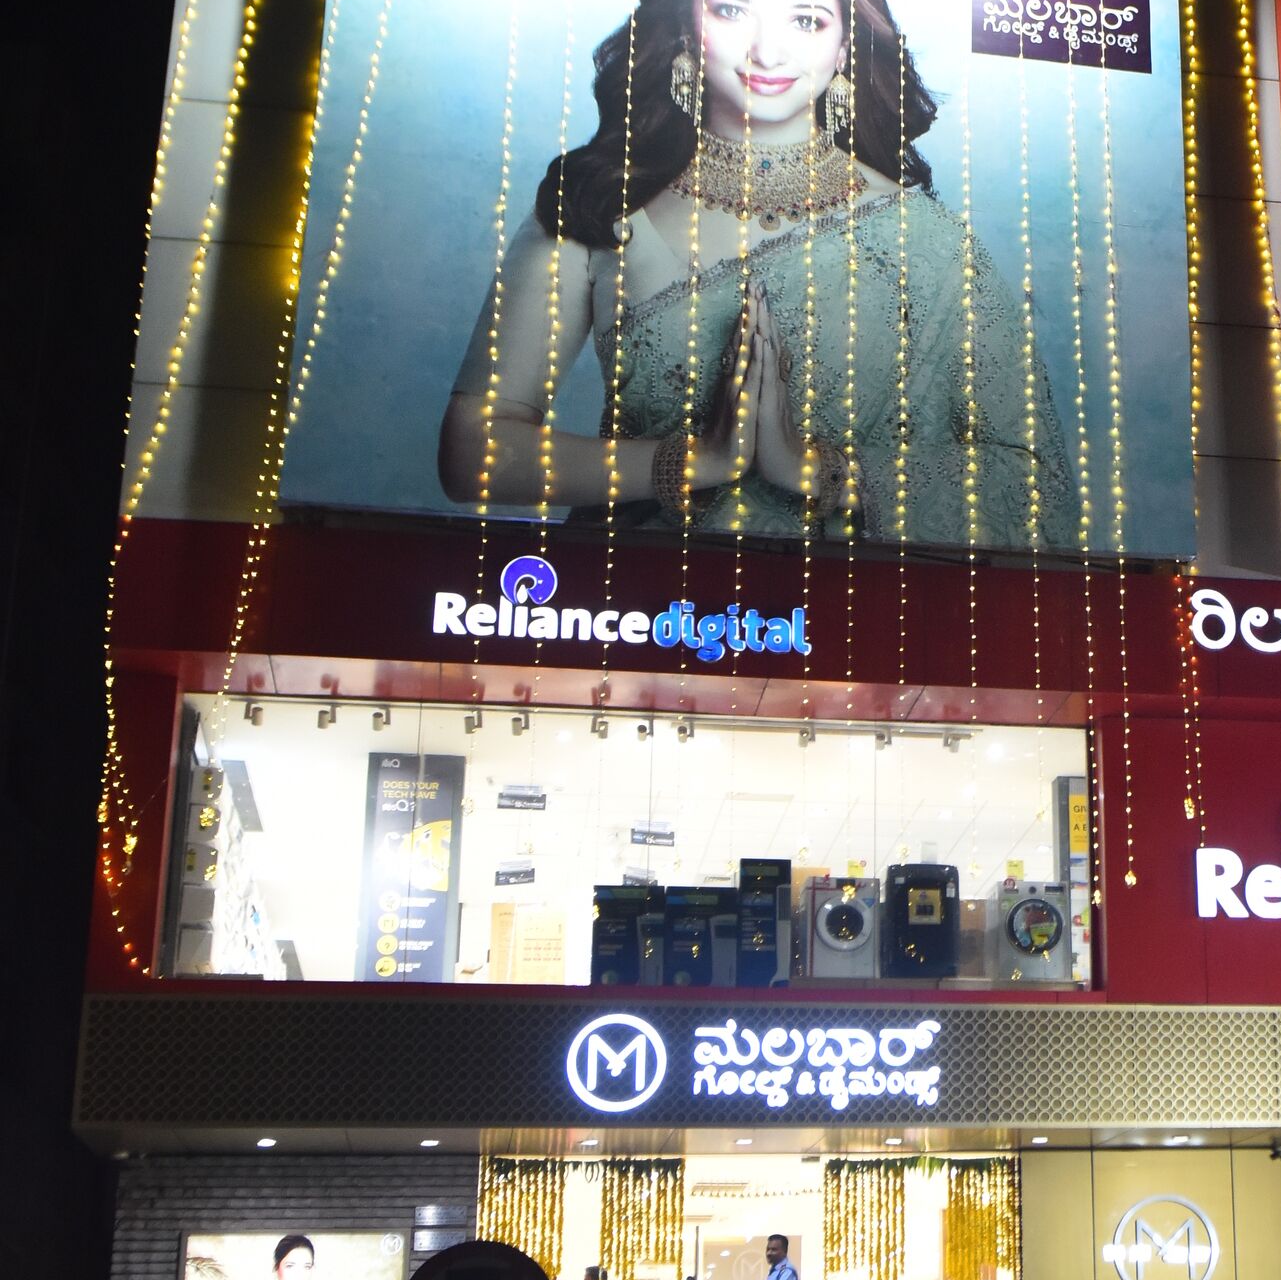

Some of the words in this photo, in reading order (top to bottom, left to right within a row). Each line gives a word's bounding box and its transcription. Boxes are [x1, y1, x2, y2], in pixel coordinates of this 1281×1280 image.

[1049, 25, 1060, 39] &
[383, 780, 409, 789] DOES
[693, 1018, 941, 1067] ಮಲಬಾರ್
